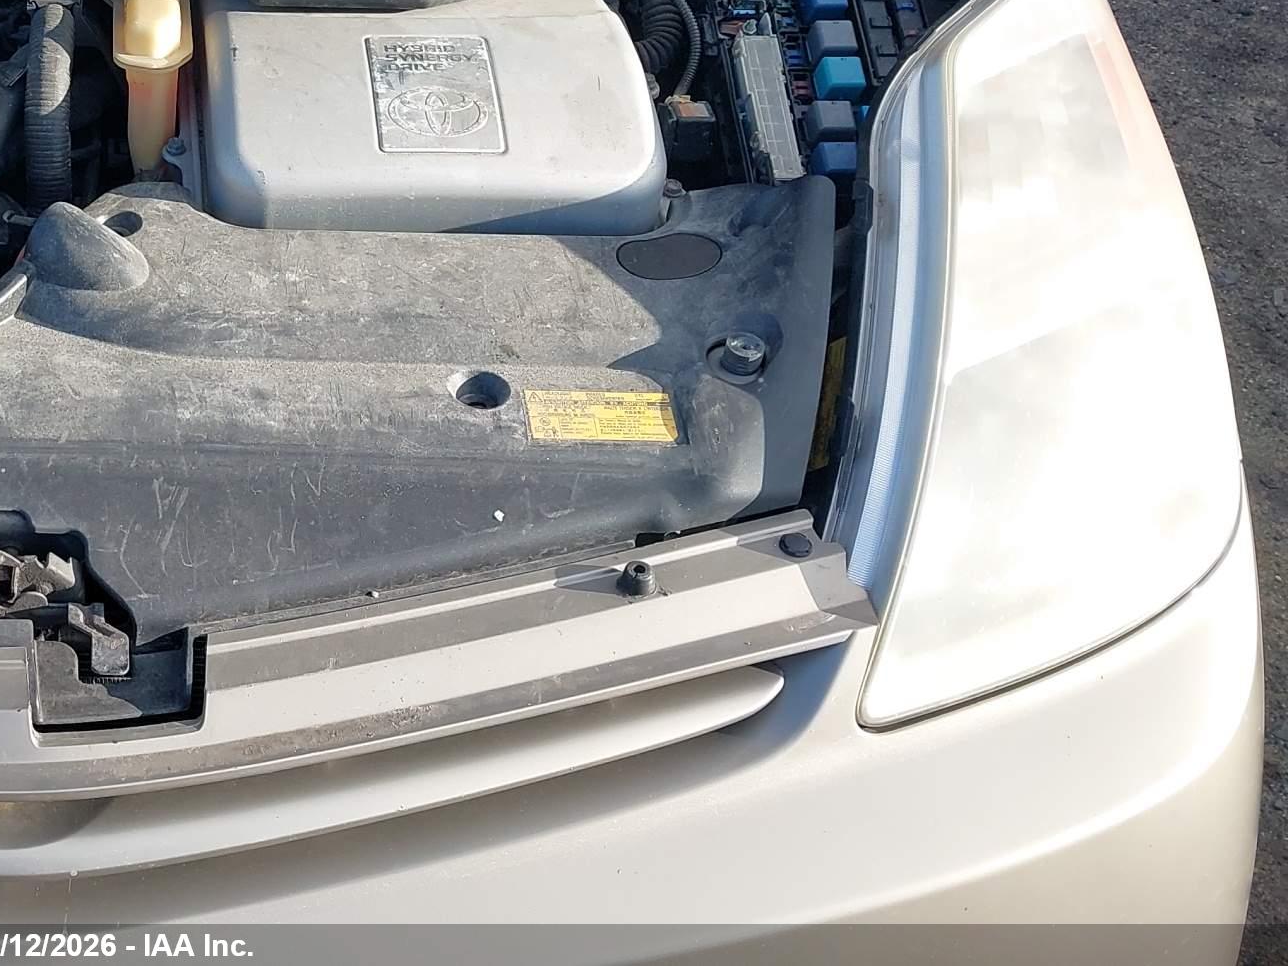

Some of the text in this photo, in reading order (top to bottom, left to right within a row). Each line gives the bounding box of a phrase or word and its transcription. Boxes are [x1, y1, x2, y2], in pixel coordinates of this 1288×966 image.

[383, 44, 456, 53] HYBRID
[385, 53, 476, 62] SYNERGY
[388, 63, 447, 72] DRIVE
